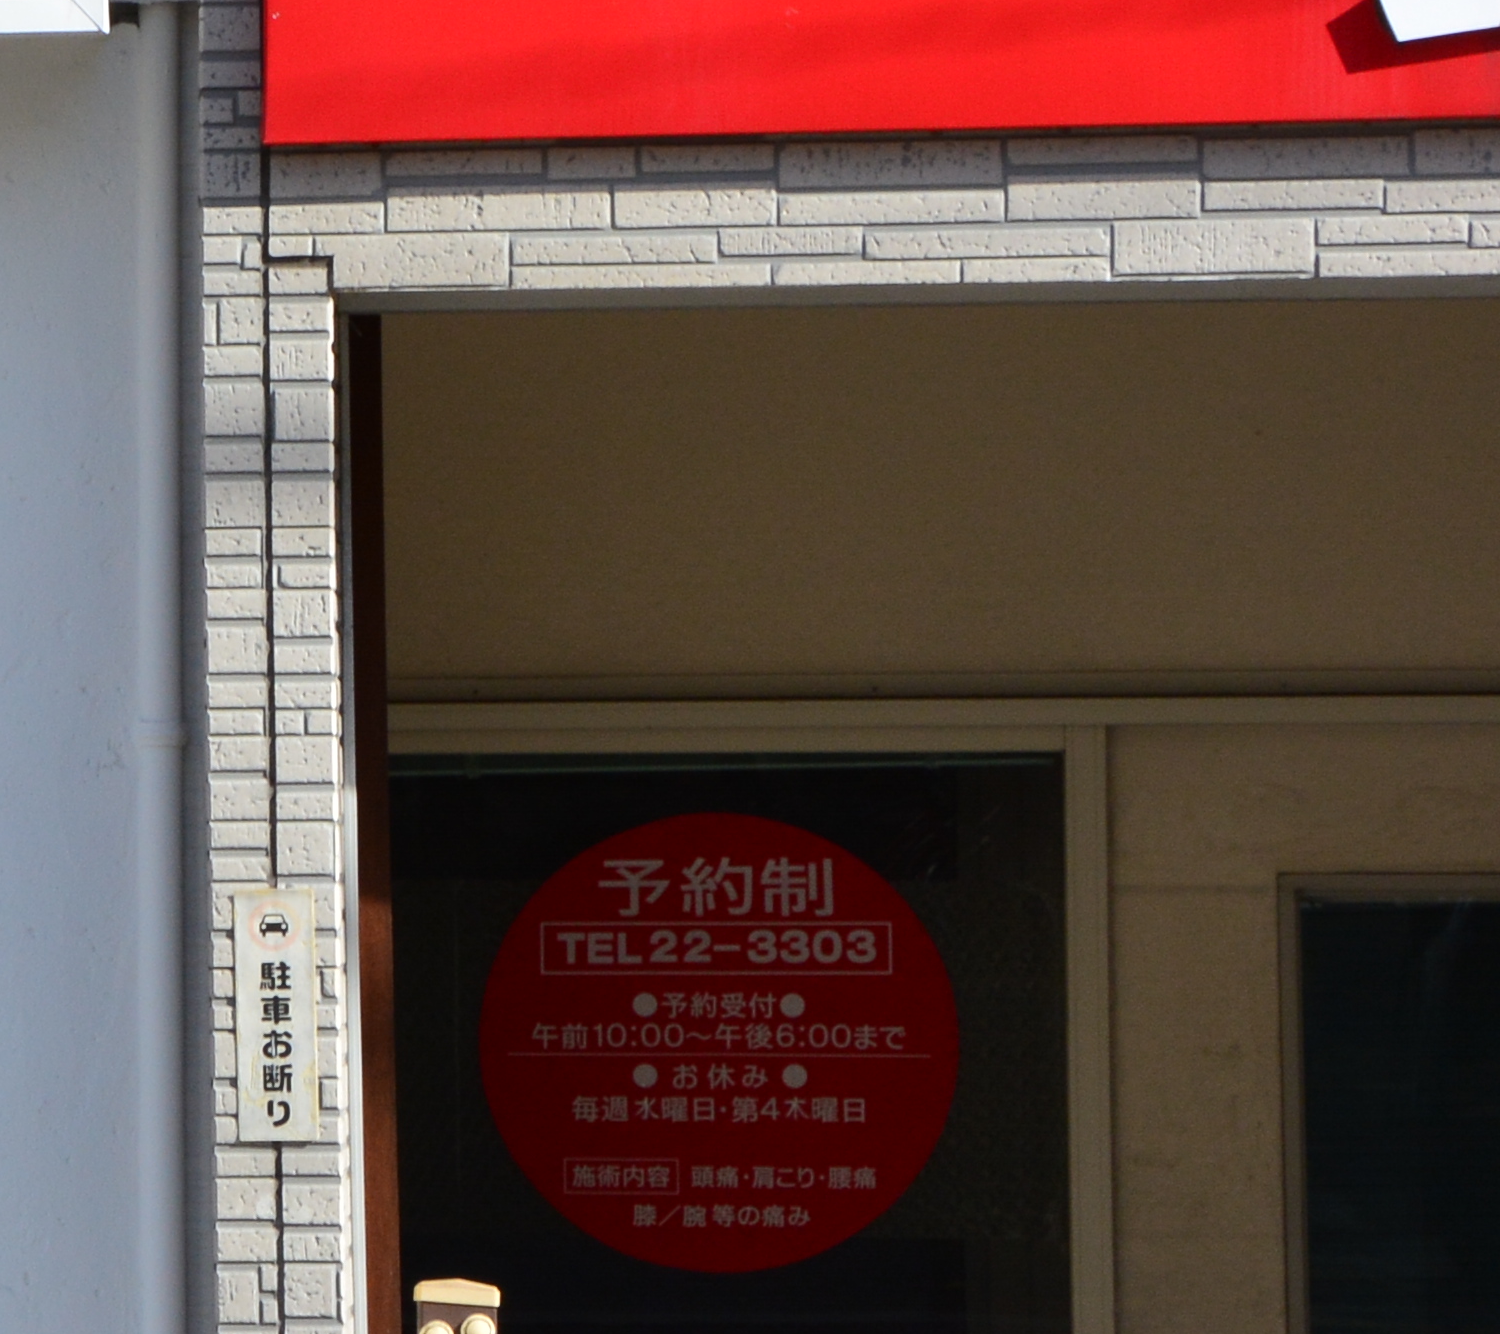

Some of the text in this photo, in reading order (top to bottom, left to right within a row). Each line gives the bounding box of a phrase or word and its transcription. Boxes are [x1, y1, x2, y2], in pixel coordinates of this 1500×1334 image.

[597, 857, 835, 917] 予約制
[259, 961, 293, 1128] 駐車お断り
[571, 1165, 671, 1189] 施術内容
